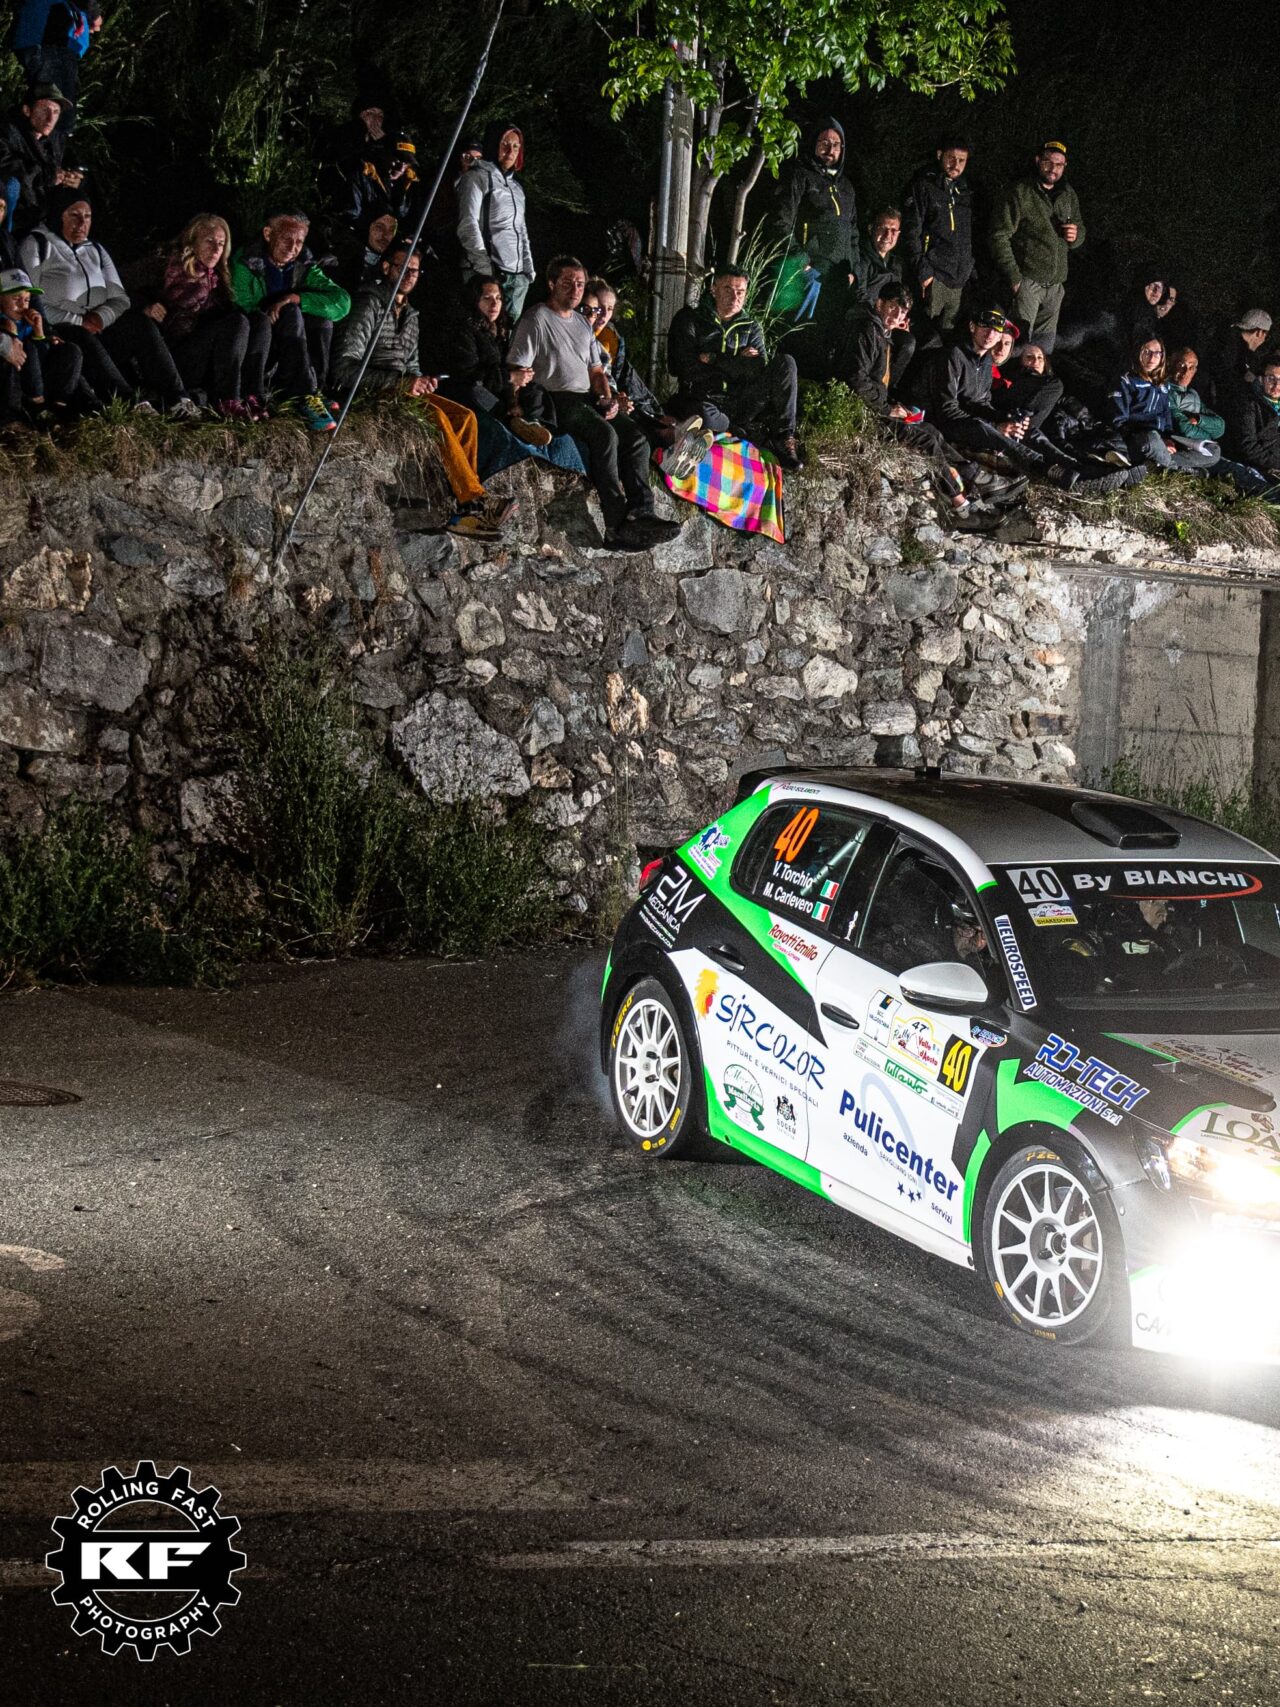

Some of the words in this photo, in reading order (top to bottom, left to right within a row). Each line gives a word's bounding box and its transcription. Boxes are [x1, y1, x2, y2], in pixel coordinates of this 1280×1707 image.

[774, 805, 820, 863] 40
[772, 861, 780, 876] V.
[780, 863, 814, 887] Torchio
[1018, 869, 1063, 900] 40
[1072, 873, 1112, 892] By
[1123, 870, 1249, 888] BIANCHI
[762, 882, 772, 897] M.
[774, 888, 814, 914] Carlevero
[999, 926, 1035, 1006] EUROSPEED
[761, 1062, 788, 1085] VERNICI
[942, 1040, 972, 1092] 40
[1024, 1062, 1108, 1115] AUTOMAZIONI
[839, 1089, 959, 1201] Pulicenter
[842, 1132, 868, 1157] azienda
[931, 1202, 953, 1225] servizi
